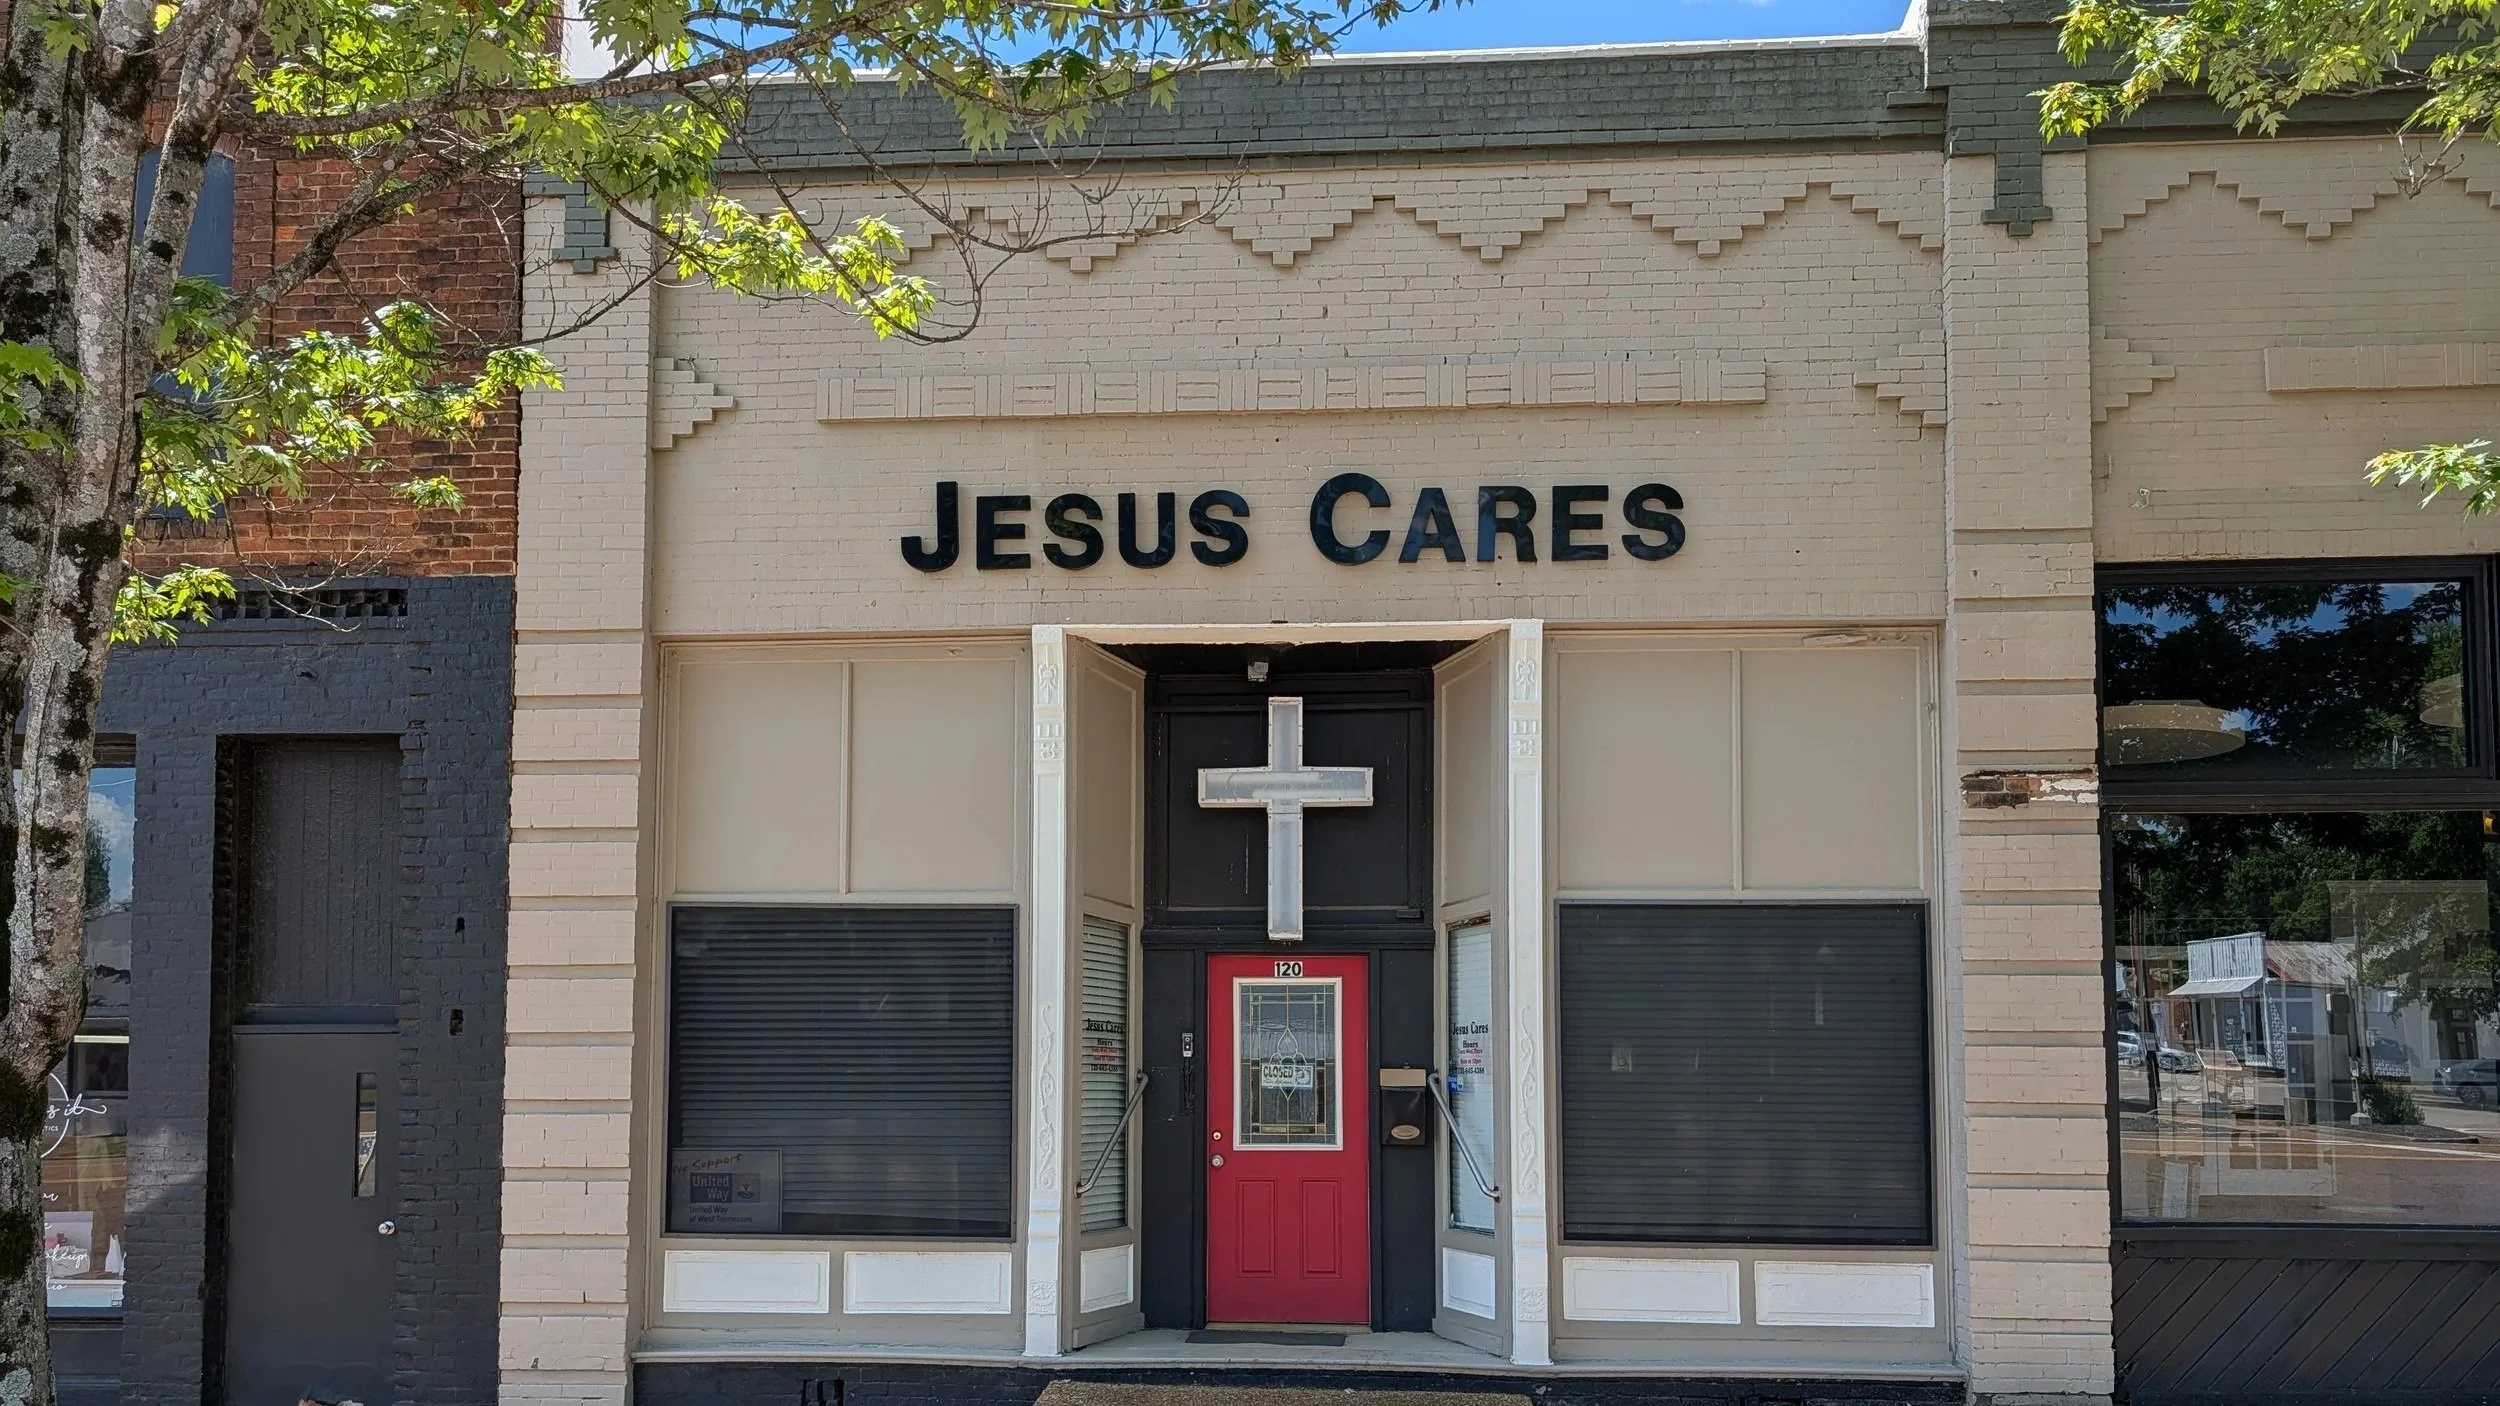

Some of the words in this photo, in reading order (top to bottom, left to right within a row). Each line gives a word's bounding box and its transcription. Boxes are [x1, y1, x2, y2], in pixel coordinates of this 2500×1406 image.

[900, 480, 1251, 574] JESUS
[1308, 471, 1687, 568] CARES
[1275, 962, 1302, 977] 120
[1086, 1018, 1104, 1032] Jesus
[1105, 1020, 1124, 1034] Cares
[1452, 1022, 1469, 1035] Jesus
[1470, 1021, 1489, 1034] Cares
[1263, 1065, 1294, 1078] CLOSED
[692, 1152, 745, 1171] Support
[692, 1175, 730, 1188] United
[706, 1188, 730, 1202] Way
[689, 1205, 712, 1214] United
[713, 1205, 729, 1216] Way
[45, 1243, 88, 1269] akeup
